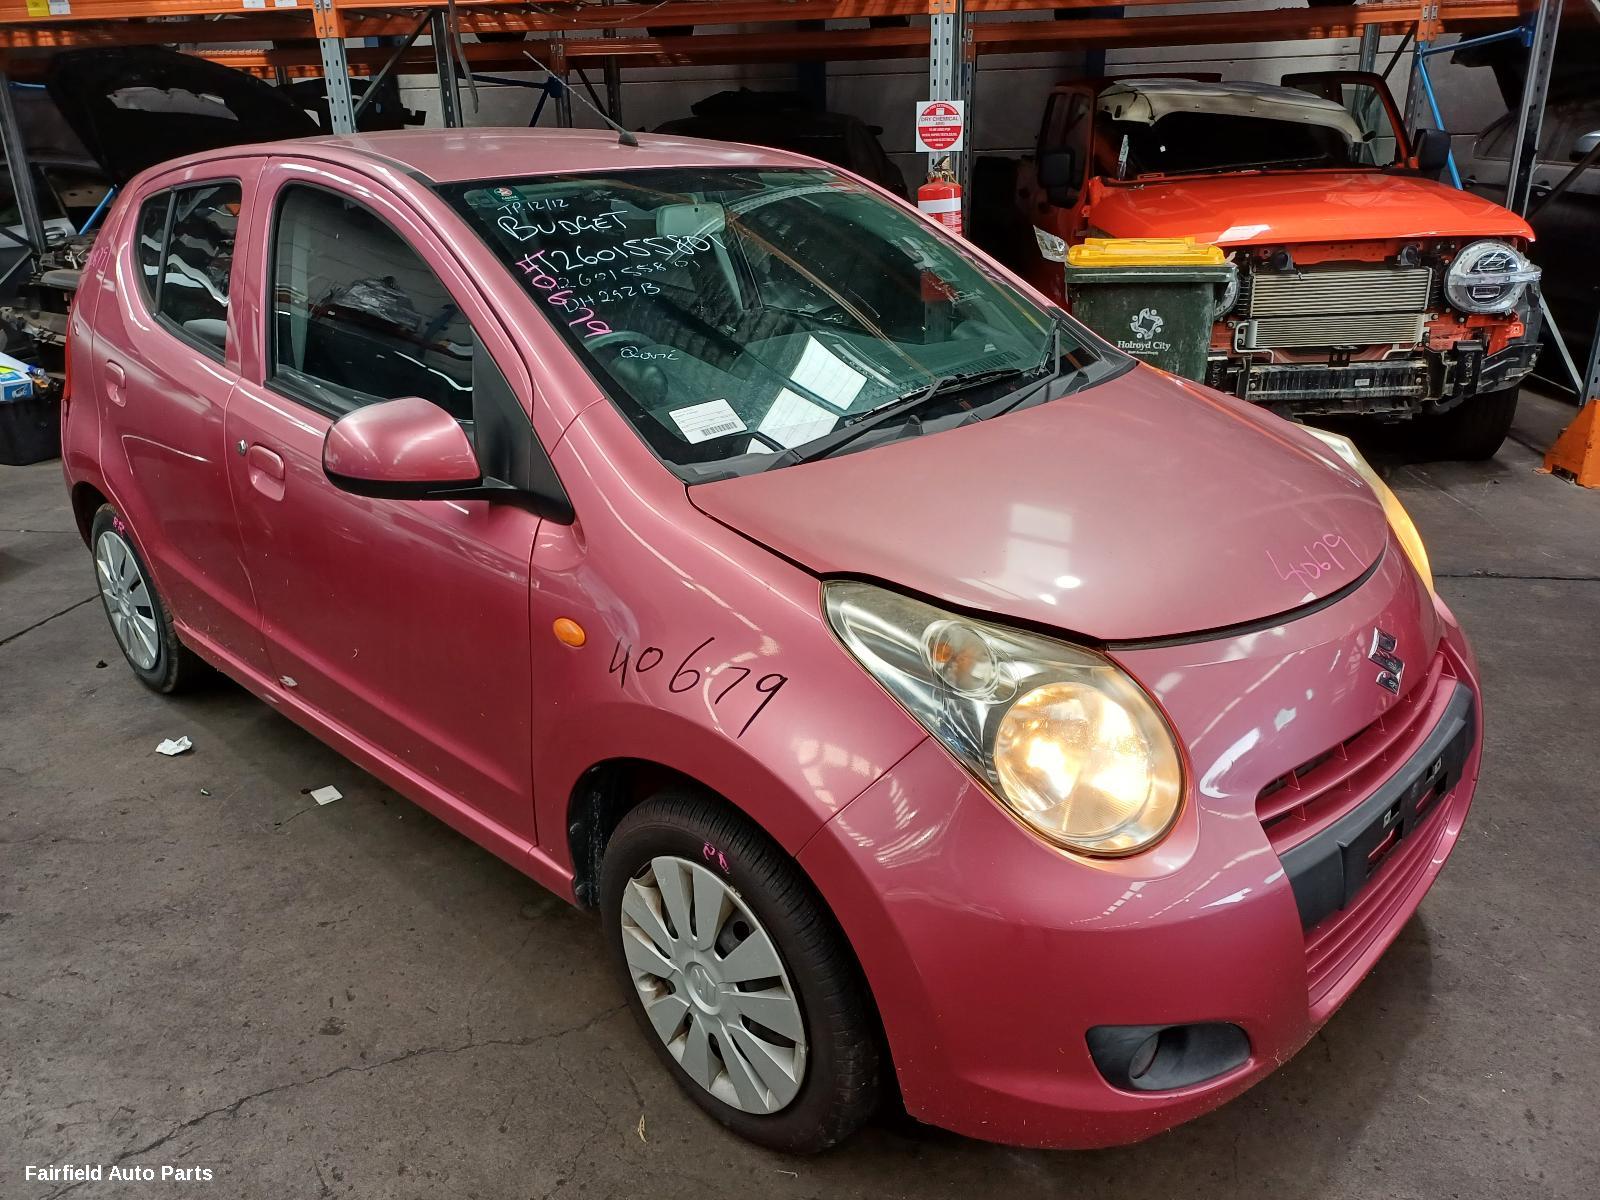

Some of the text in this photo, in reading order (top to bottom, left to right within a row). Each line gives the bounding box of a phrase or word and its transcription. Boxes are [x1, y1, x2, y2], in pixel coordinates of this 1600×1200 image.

[498, 210, 628, 241] BUDGET
[1117, 340, 1152, 351] Holroyd
[1152, 341, 1171, 353] City
[1265, 533, 1368, 592] 40679
[608, 637, 789, 739] 40679
